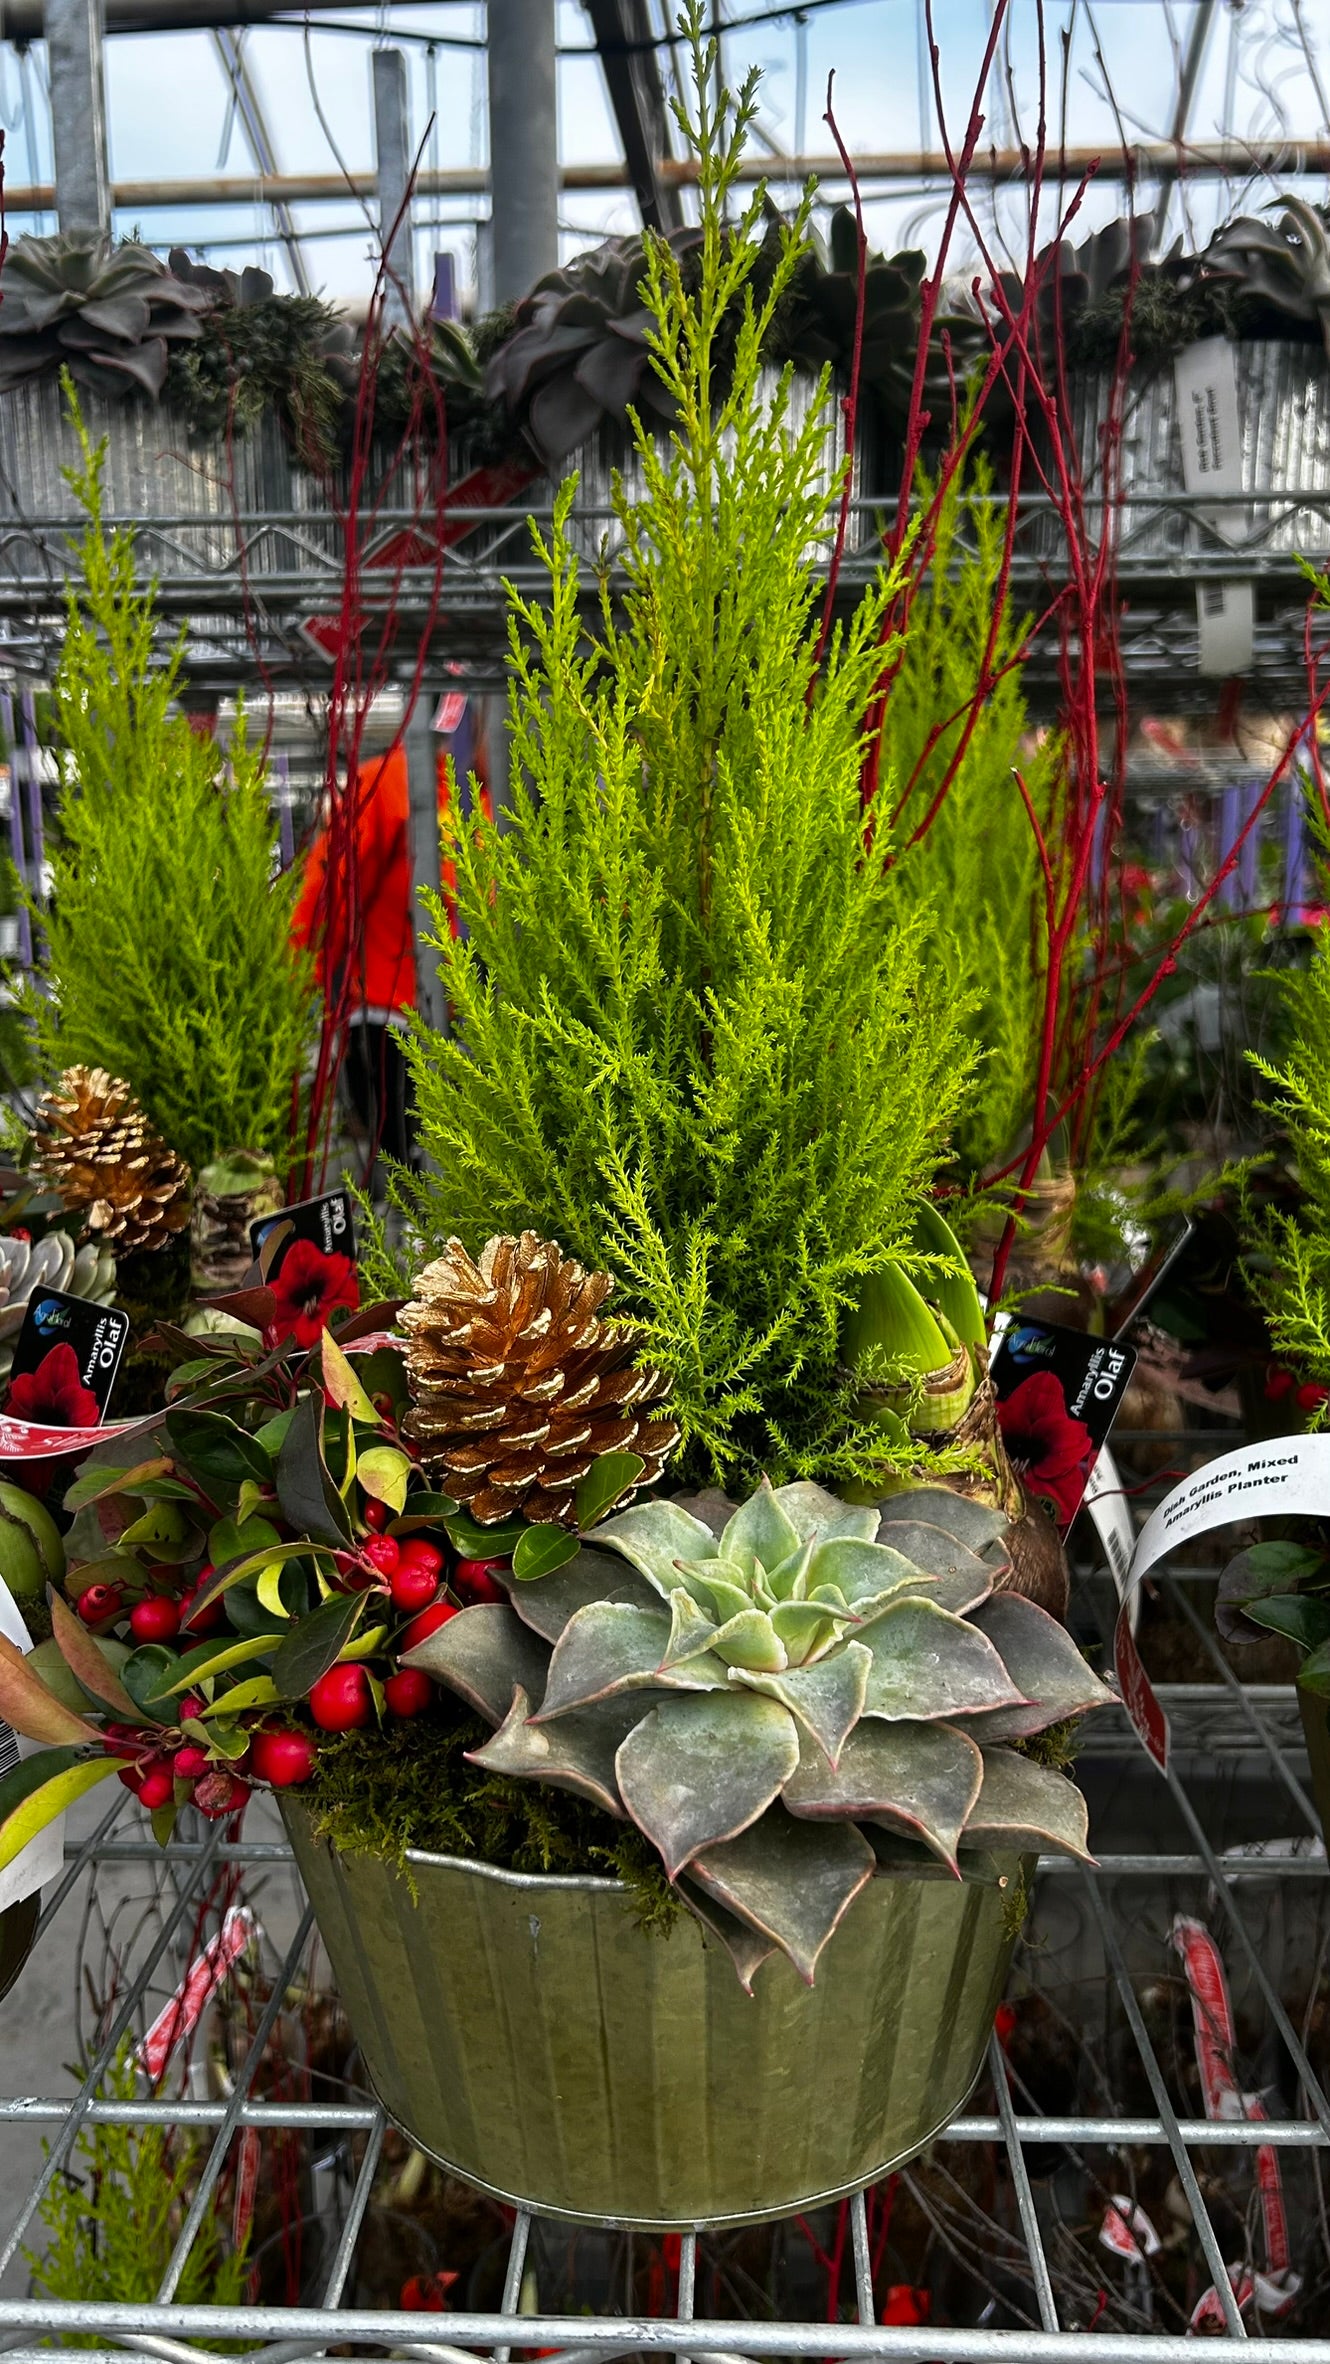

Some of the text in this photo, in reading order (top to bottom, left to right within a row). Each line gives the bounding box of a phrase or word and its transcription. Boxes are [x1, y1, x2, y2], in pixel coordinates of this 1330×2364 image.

[82, 1317, 107, 1385] Amaryllis
[100, 1316, 122, 1368] Olaf
[1070, 1347, 1105, 1417] Amaryllis
[1094, 1347, 1126, 1400] Olaf
[1163, 1455, 1299, 1519] Dish Garden, Mixed
[1165, 1474, 1289, 1529] Amaryllis Planter
